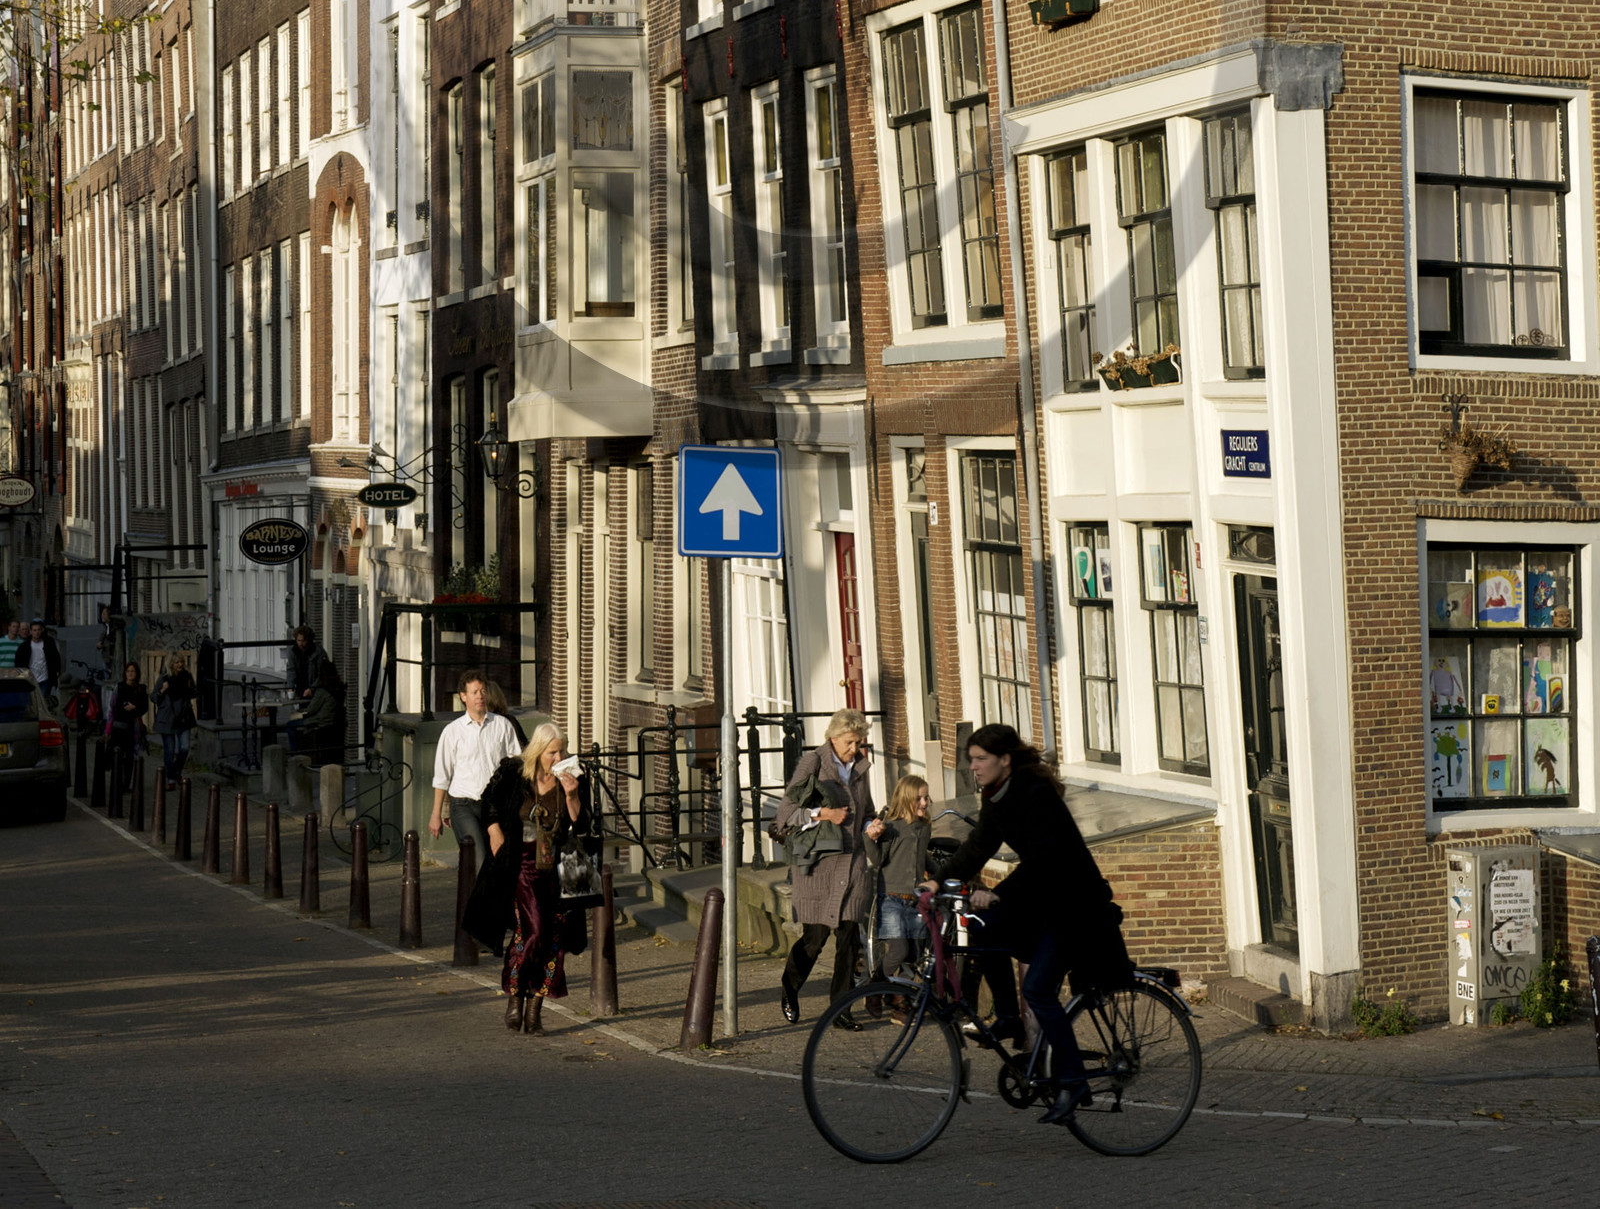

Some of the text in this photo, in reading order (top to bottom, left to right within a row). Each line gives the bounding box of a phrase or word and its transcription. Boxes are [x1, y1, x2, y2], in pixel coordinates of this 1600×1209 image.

[1228, 435, 1259, 452] REGULIERS
[1224, 455, 1247, 472] GRACHT
[365, 490, 410, 501] HOTEL
[253, 543, 296, 554] Lounge
[1457, 983, 1474, 999] BNE
